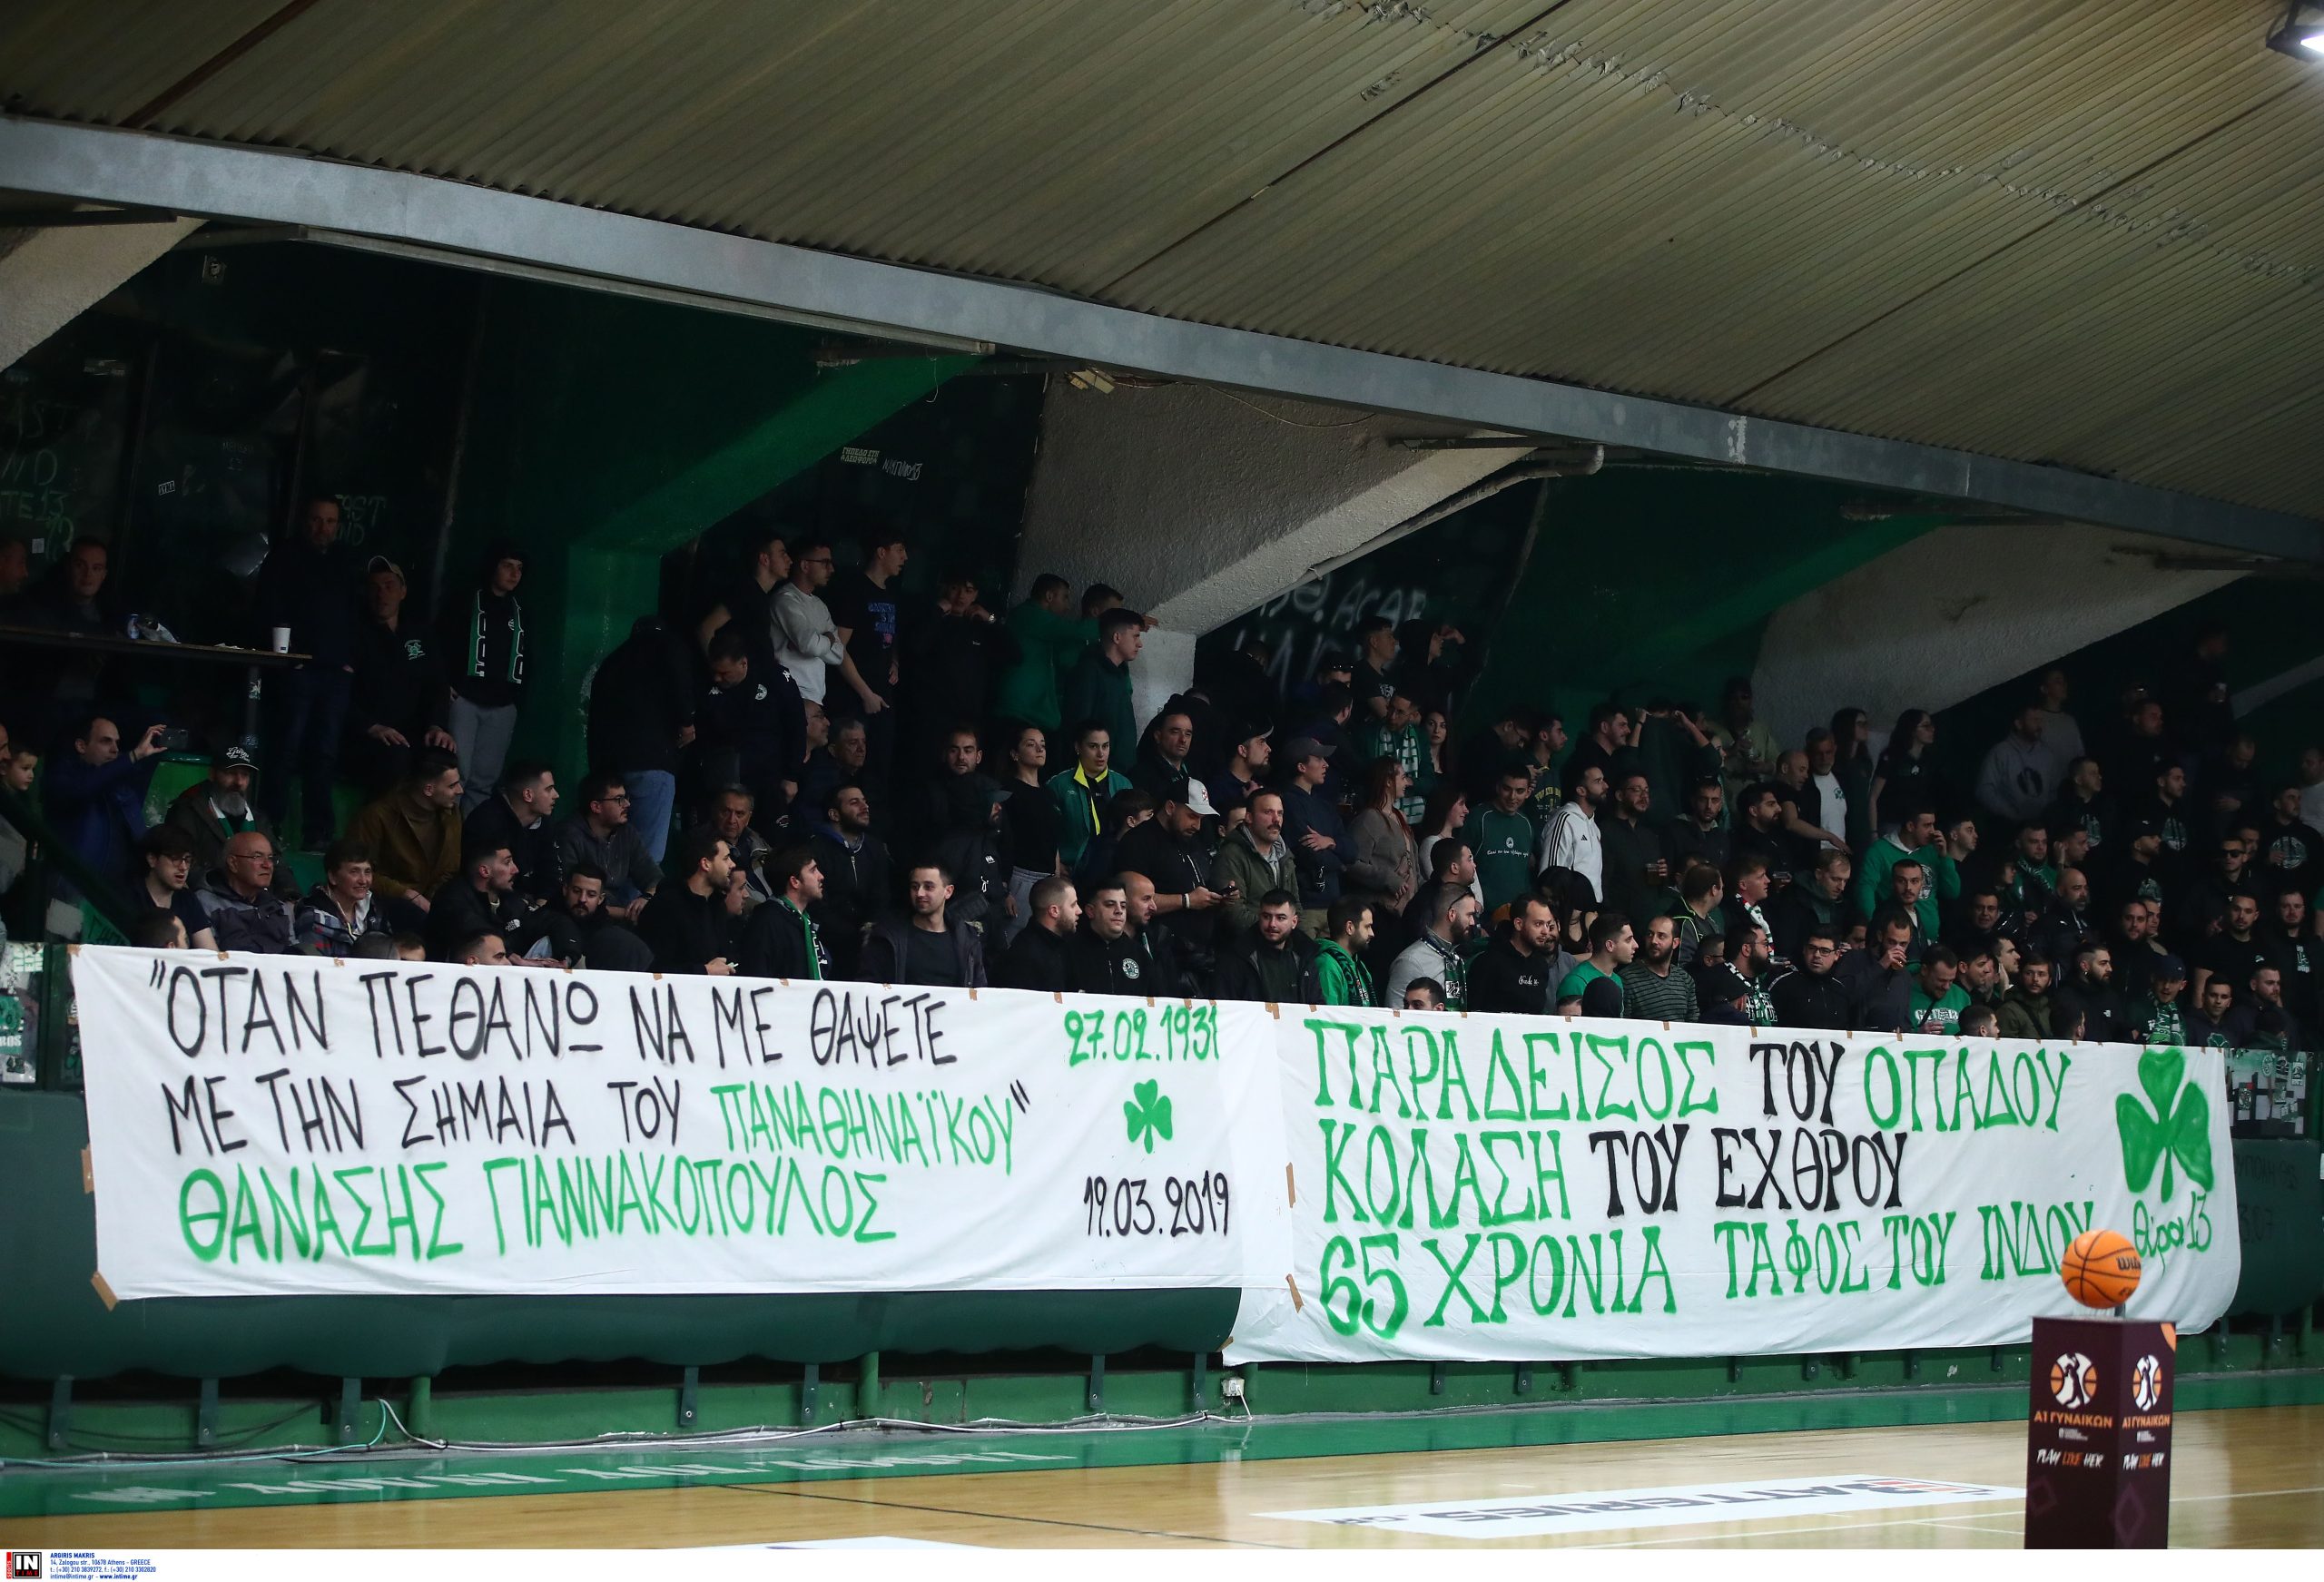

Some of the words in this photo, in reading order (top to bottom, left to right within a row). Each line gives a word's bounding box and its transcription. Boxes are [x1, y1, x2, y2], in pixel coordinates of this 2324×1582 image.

[359, 970, 603, 1061] ΠΕΘΑΝΩ
[629, 982, 694, 1065] ΝΑ
[712, 986, 783, 1069] ΜΕ
[809, 987, 958, 1068] ΘΑΨΕΤΕ
[1064, 1005, 1220, 1068] 27.02.1931
[162, 1075, 248, 1155] ΜΕ
[255, 1067, 364, 1154] ΤΗΝ
[393, 1076, 576, 1149] ΣΗΜΑΙΑ
[607, 1076, 681, 1146] ΤΟΥ
[1304, 1018, 1719, 1124] ΠΑΡΑΔΕΙΣΟΣ
[1748, 1040, 1846, 1127] ΤΟΥ
[1864, 1046, 2072, 1132] ΟΠΑΔΟΥ
[179, 1162, 464, 1264] ΘΑΝΑΣΗΣ
[483, 1149, 897, 1256] ΓΙΑΝΝΑΚΟΠΟΥΛΟΣ
[1083, 1169, 1230, 1239] 19.03.2019
[1318, 1117, 1571, 1230] ΚΟΛΑΣΗ
[1590, 1123, 1689, 1220] ΤΟΥ
[1712, 1127, 1907, 1213] ΕΧΘΡΟΥ
[2186, 1189, 2212, 1253] 13
[1318, 1232, 1410, 1340] 65
[1420, 1225, 1678, 1328] ΧΡΟΝΙΑ
[1713, 1218, 1869, 1299] ΤΑΦΟΣ
[1882, 1212, 1957, 1292] ΤΟΥ
